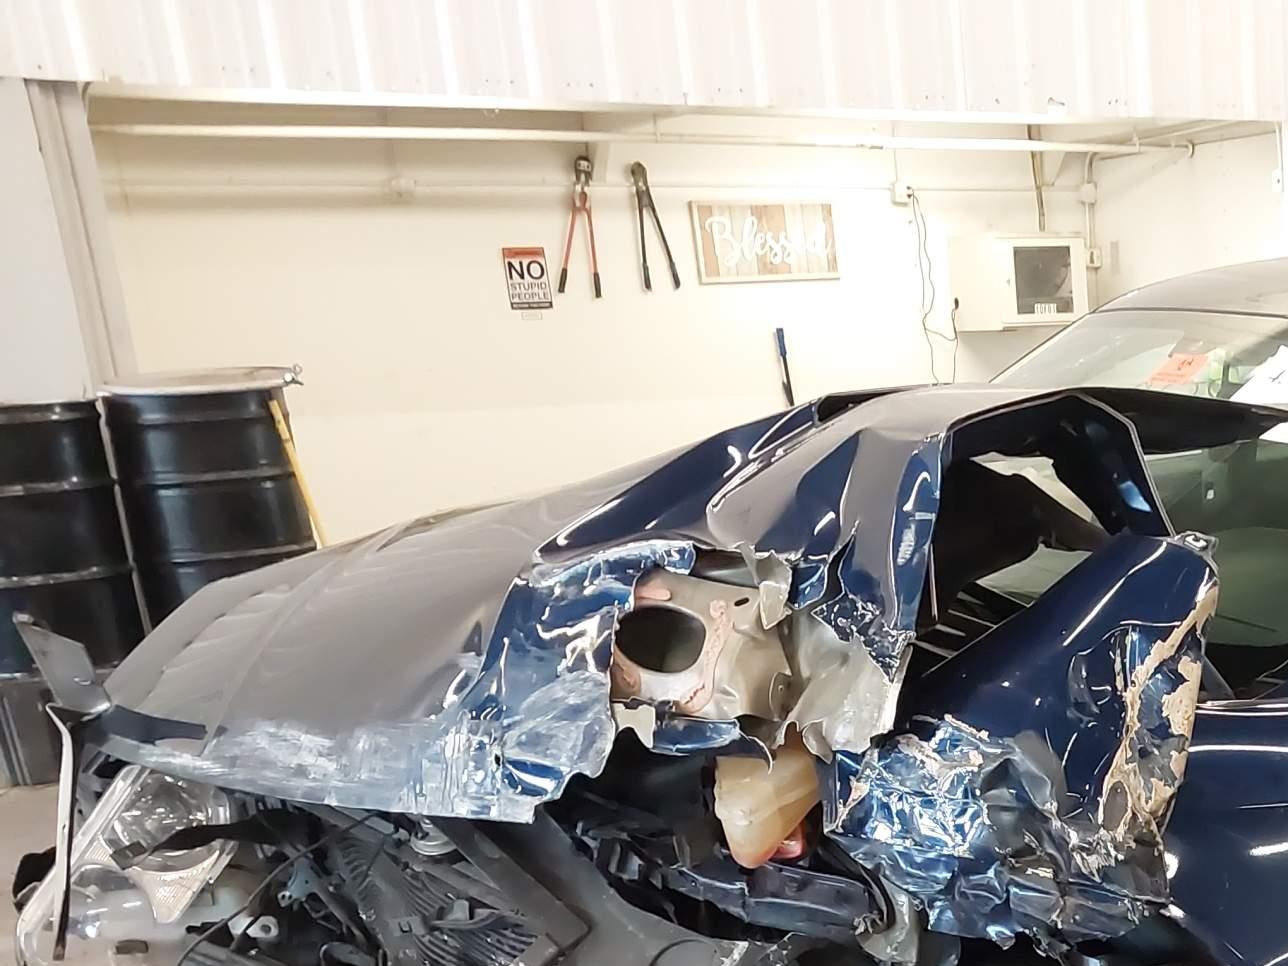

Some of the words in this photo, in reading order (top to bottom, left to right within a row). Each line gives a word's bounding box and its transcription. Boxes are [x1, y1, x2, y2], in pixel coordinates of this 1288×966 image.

[705, 215, 832, 267] Blessd
[507, 260, 545, 280] NO
[510, 281, 547, 291] STUPID
[511, 291, 550, 301] PEOPLE
